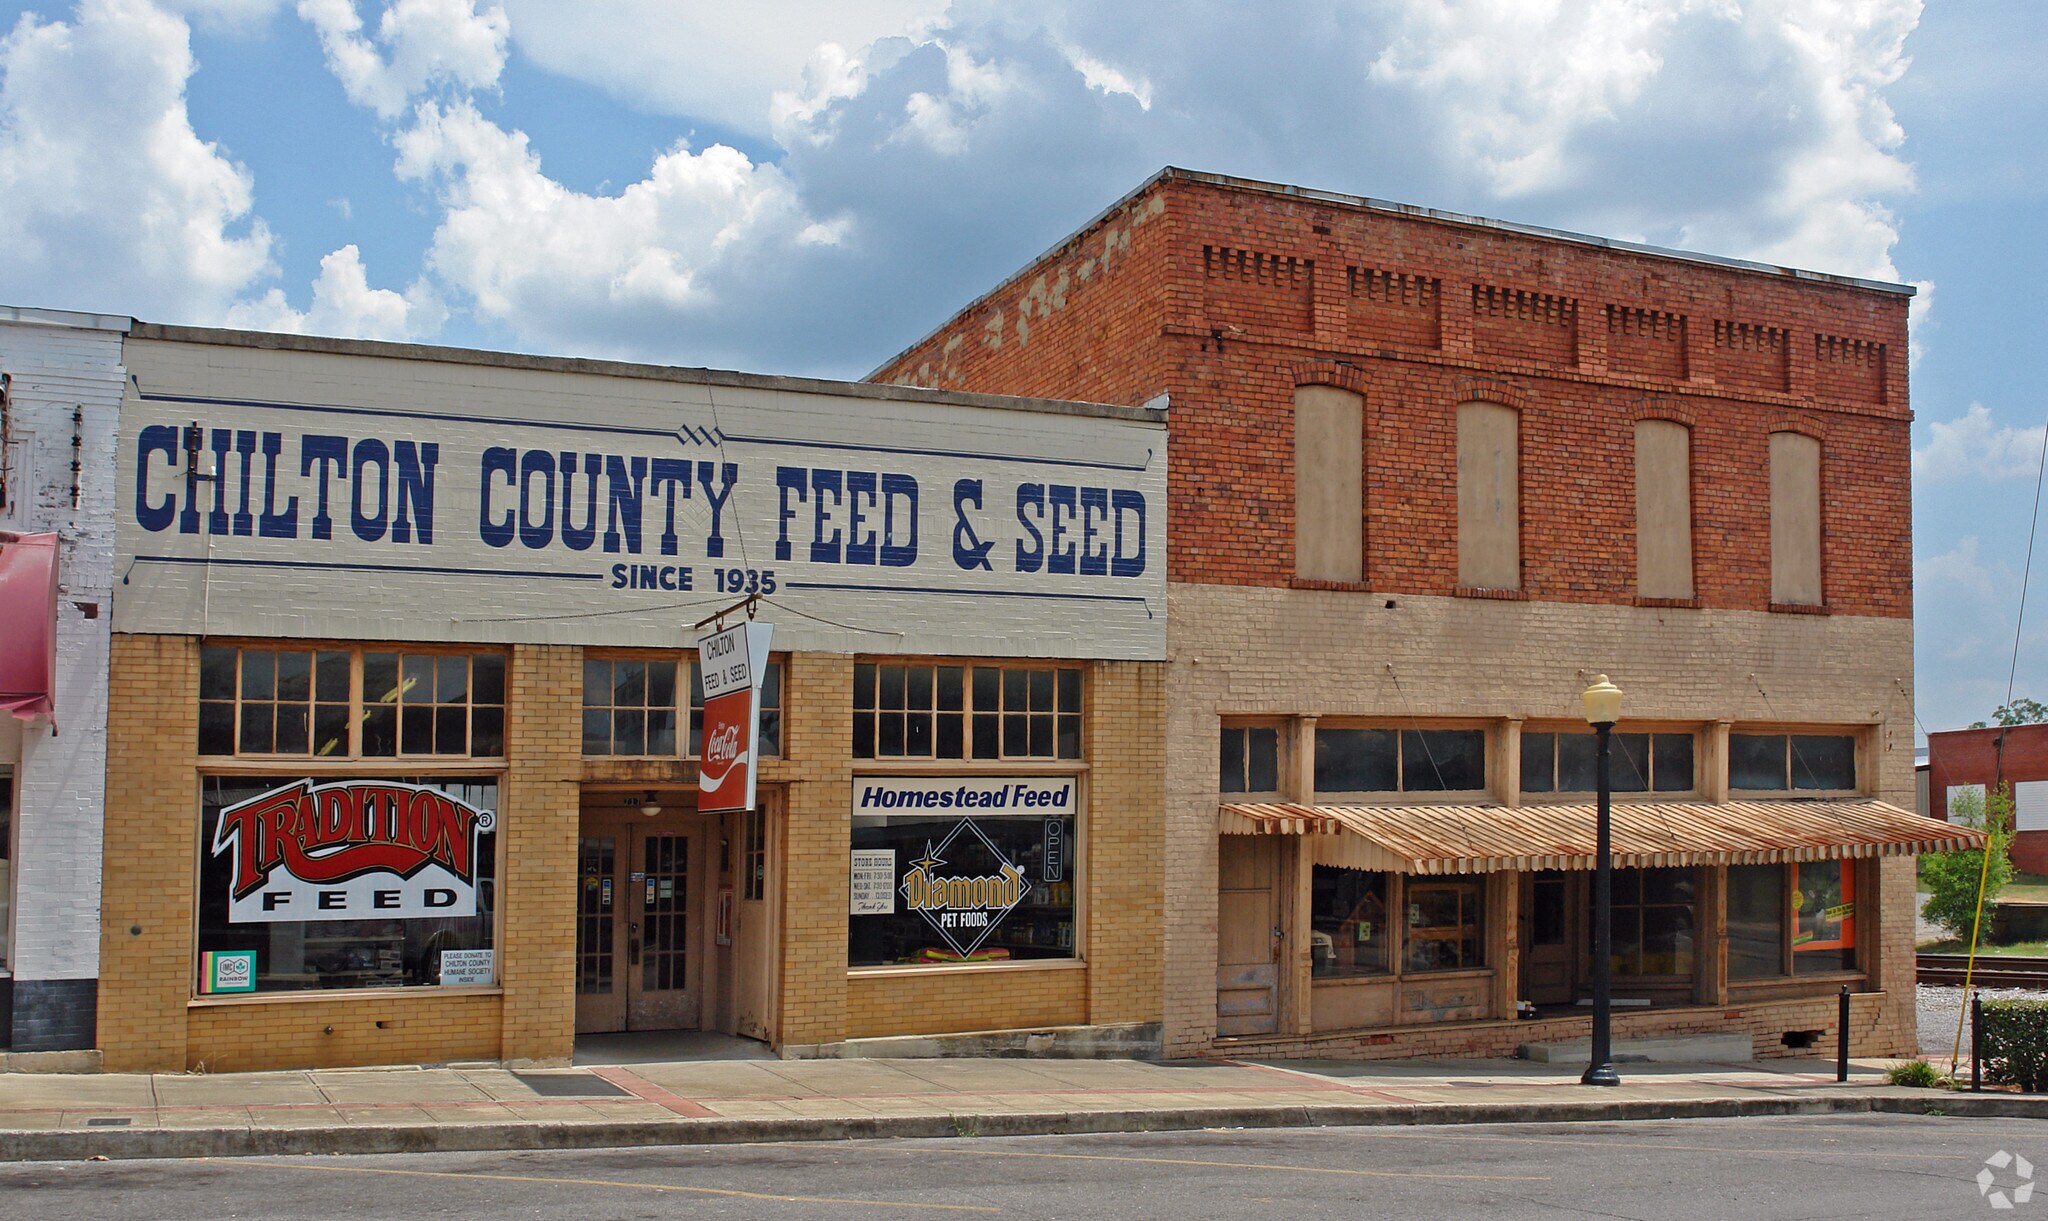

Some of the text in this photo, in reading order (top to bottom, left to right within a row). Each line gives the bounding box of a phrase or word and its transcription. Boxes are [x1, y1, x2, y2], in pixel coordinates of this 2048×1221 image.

[135, 424, 1147, 578] CHILTON COUNTY FEED & SEED
[611, 563, 777, 595] SINCE 1935
[706, 632, 736, 661] CHILTON
[705, 663, 747, 691] FEED & SEED
[861, 784, 1070, 808] Homestead Feed
[221, 786, 476, 900] TRADITION
[1046, 822, 1062, 879] OPEN
[262, 888, 457, 911] FEED
[905, 863, 1021, 909] Diamond
[941, 912, 988, 927] PET FOODS
